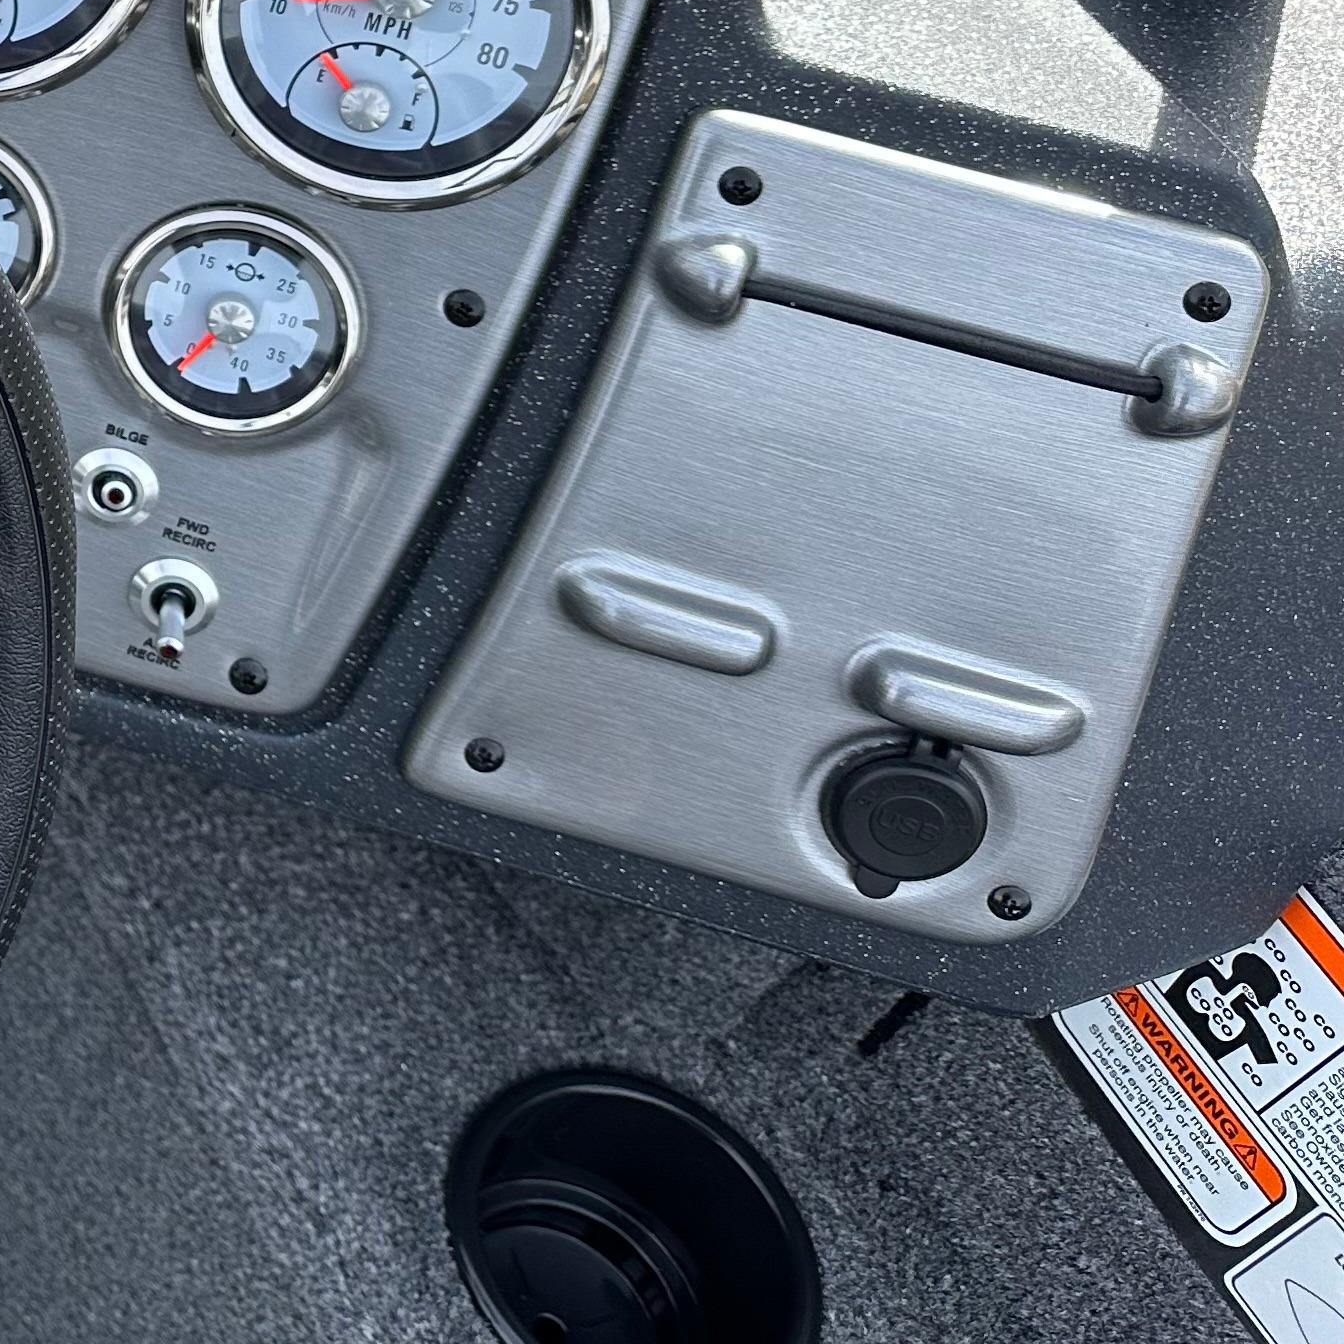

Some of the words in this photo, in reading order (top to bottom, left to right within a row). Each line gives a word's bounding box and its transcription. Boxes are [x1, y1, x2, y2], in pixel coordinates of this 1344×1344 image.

[322, 0, 356, 18] km/h
[448, 2, 463, 14] 125
[364, 12, 412, 40] MPH
[477, 42, 509, 69] 80
[316, 68, 326, 83] E
[412, 92, 421, 107] F
[199, 253, 216, 269] 15
[175, 280, 191, 296] 10
[277, 278, 296, 294] 25
[164, 313, 173, 327] 5
[278, 312, 297, 328] 30
[230, 356, 248, 372] 40
[267, 347, 286, 363] 35
[105, 424, 149, 446] BILGE
[177, 518, 209, 536] FWD
[162, 530, 217, 553] RECIRC
[127, 645, 180, 670] RECIRC
[878, 808, 939, 841] USB
[1263, 937, 1286, 963] CO
[1279, 968, 1302, 994] CO
[1189, 986, 1211, 1011] CO
[1212, 995, 1234, 1021] CO
[1283, 997, 1307, 1023] CO
[1211, 1012, 1233, 1037] CO
[1267, 1011, 1290, 1037] CO
[1312, 1013, 1336, 1039] CO
[1292, 1026, 1315, 1052] CO
[1275, 1040, 1298, 1066] CO
[1107, 1023, 1146, 1073] serious
[1144, 1073, 1176, 1111] injury
[1174, 1113, 1189, 1128] or
[1140, 1011, 1239, 1140] WARNING
[1240, 1061, 1263, 1087] CO
[1091, 1047, 1135, 1102] persons
[1133, 1100, 1146, 1118] in
[1145, 1117, 1164, 1141] the
[1099, 995, 1144, 1053] Rotating
[1140, 1053, 1191, 1112] propeller
[1189, 1115, 1216, 1145] may
[1214, 1147, 1249, 1191] cause
[1307, 1088, 1336, 1118] and
[1087, 1022, 1115, 1056] Shut
[1112, 1056, 1130, 1075] off
[1126, 1076, 1164, 1124] engine
[1163, 1123, 1193, 1163] when
[1192, 1164, 1220, 1195] near
[1299, 1095, 1324, 1124] Get
[1279, 1108, 1305, 1139] See
[1270, 1117, 1313, 1168] carbon
[1288, 1102, 1344, 1174] monoxide
